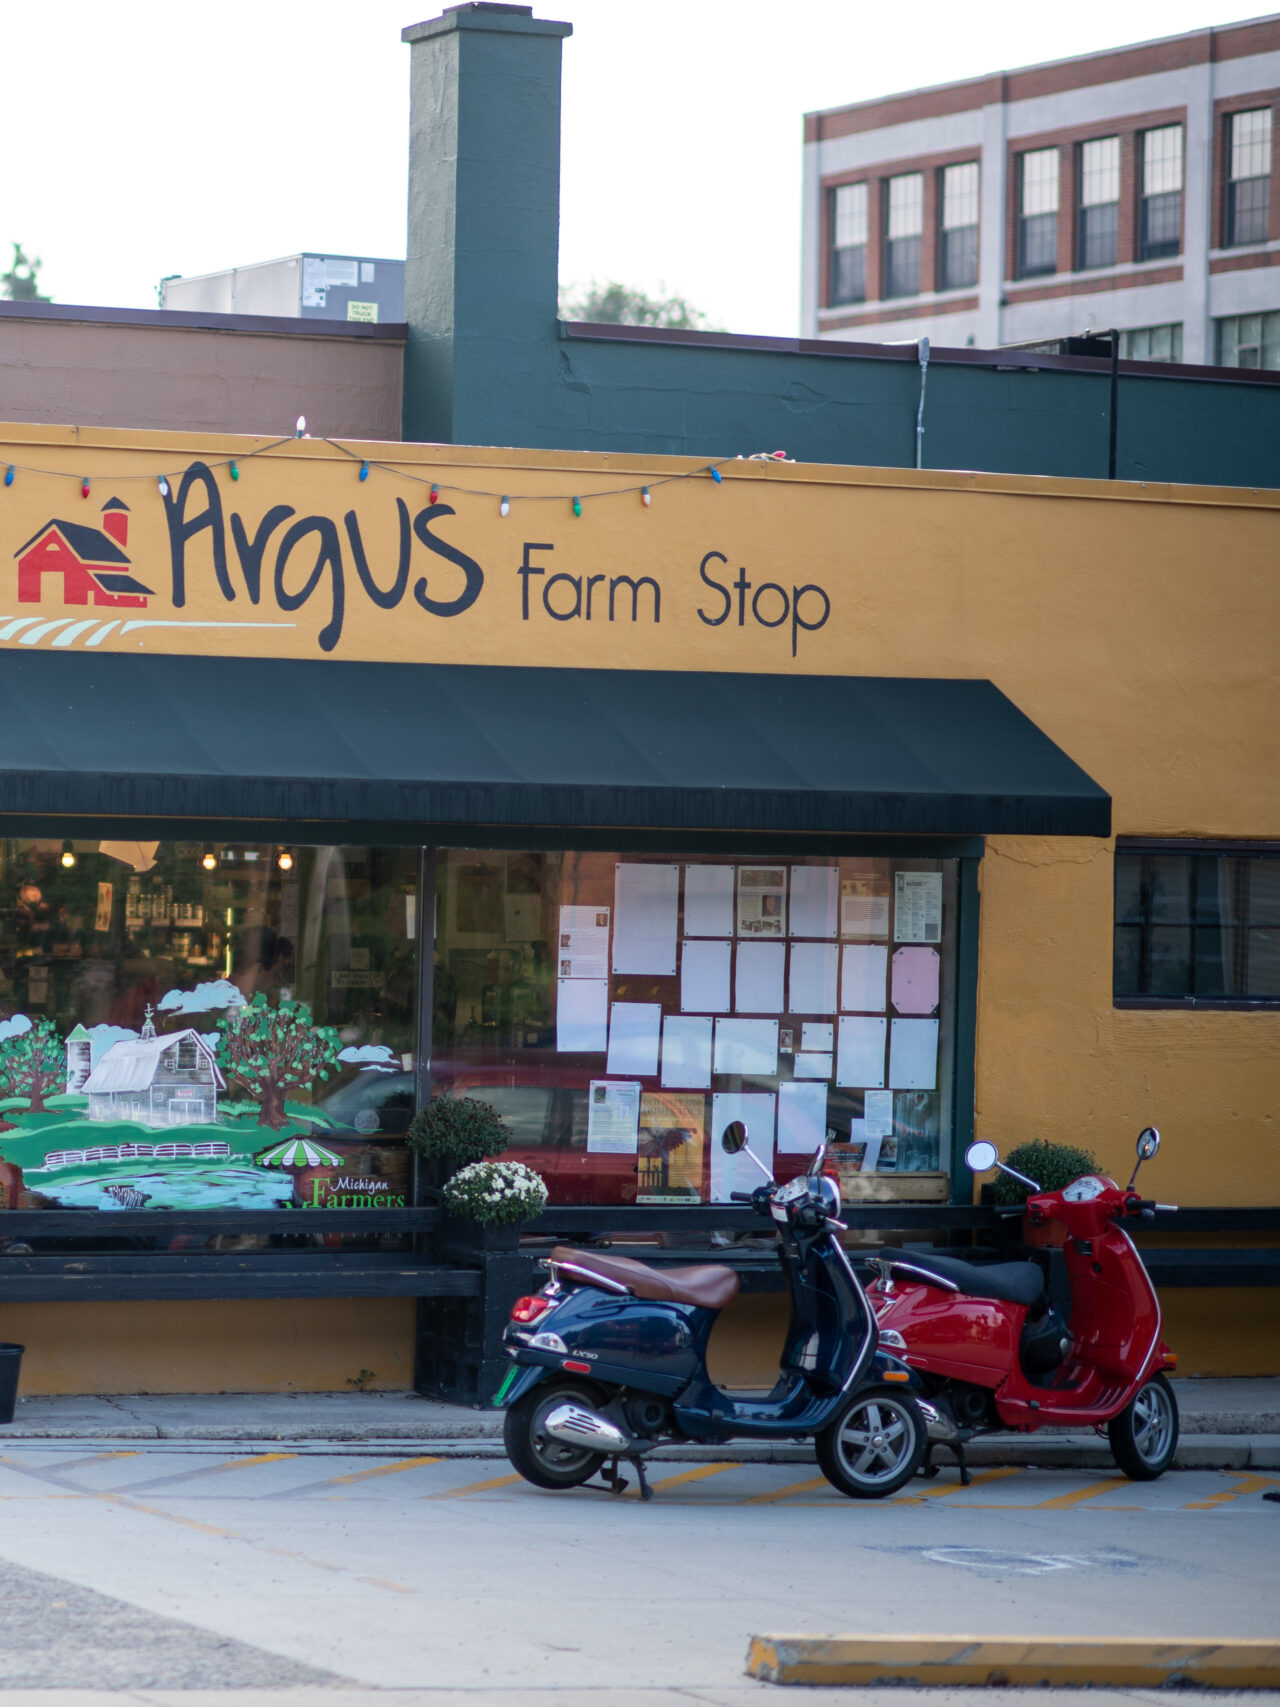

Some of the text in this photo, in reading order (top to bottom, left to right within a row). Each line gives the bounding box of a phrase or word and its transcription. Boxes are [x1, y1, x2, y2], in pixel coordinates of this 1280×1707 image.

[163, 461, 832, 659] Argus Farm Stop
[310, 1178, 405, 1208] Farmers
[330, 1177, 389, 1195] Michigan
